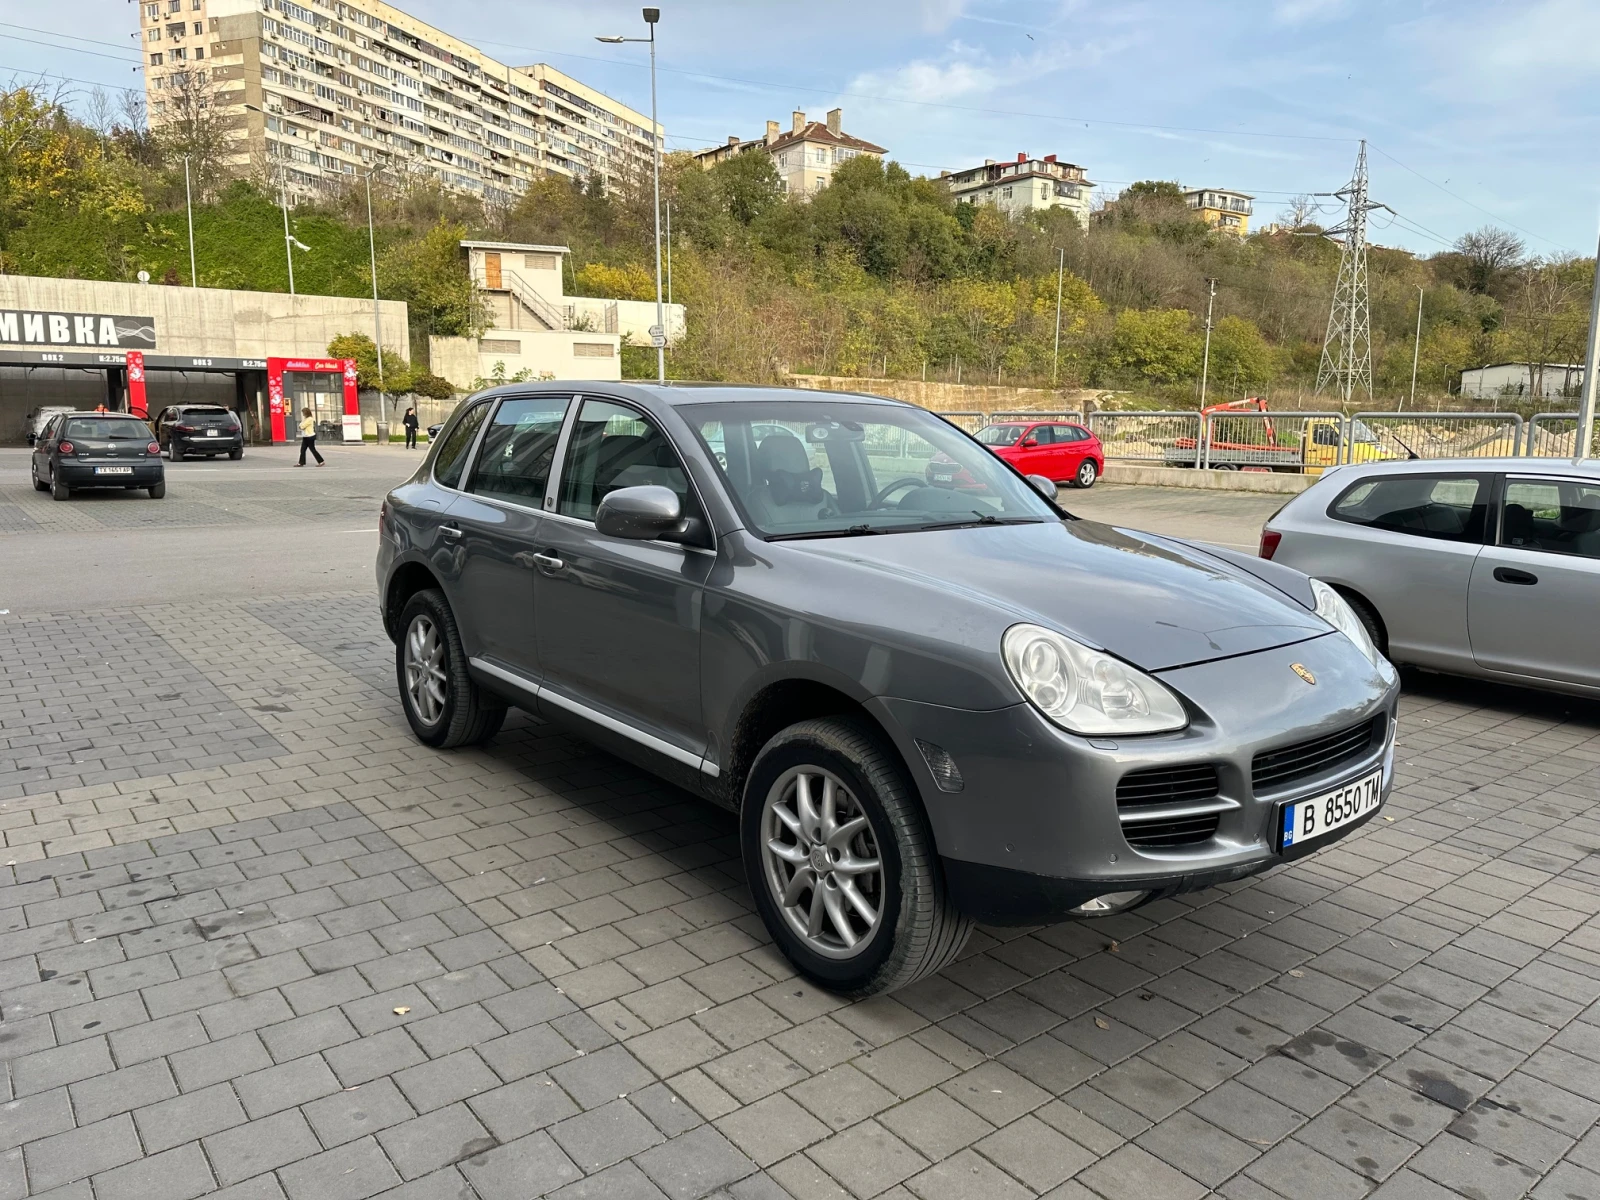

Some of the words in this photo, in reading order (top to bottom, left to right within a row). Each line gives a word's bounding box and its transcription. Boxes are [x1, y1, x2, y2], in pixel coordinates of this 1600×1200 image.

[0, 312, 119, 345] МИВКА
[1303, 804, 1315, 836] B
[1324, 785, 1361, 827] 8550
[1364, 774, 1380, 809] TM
[1283, 830, 1293, 842] BG
